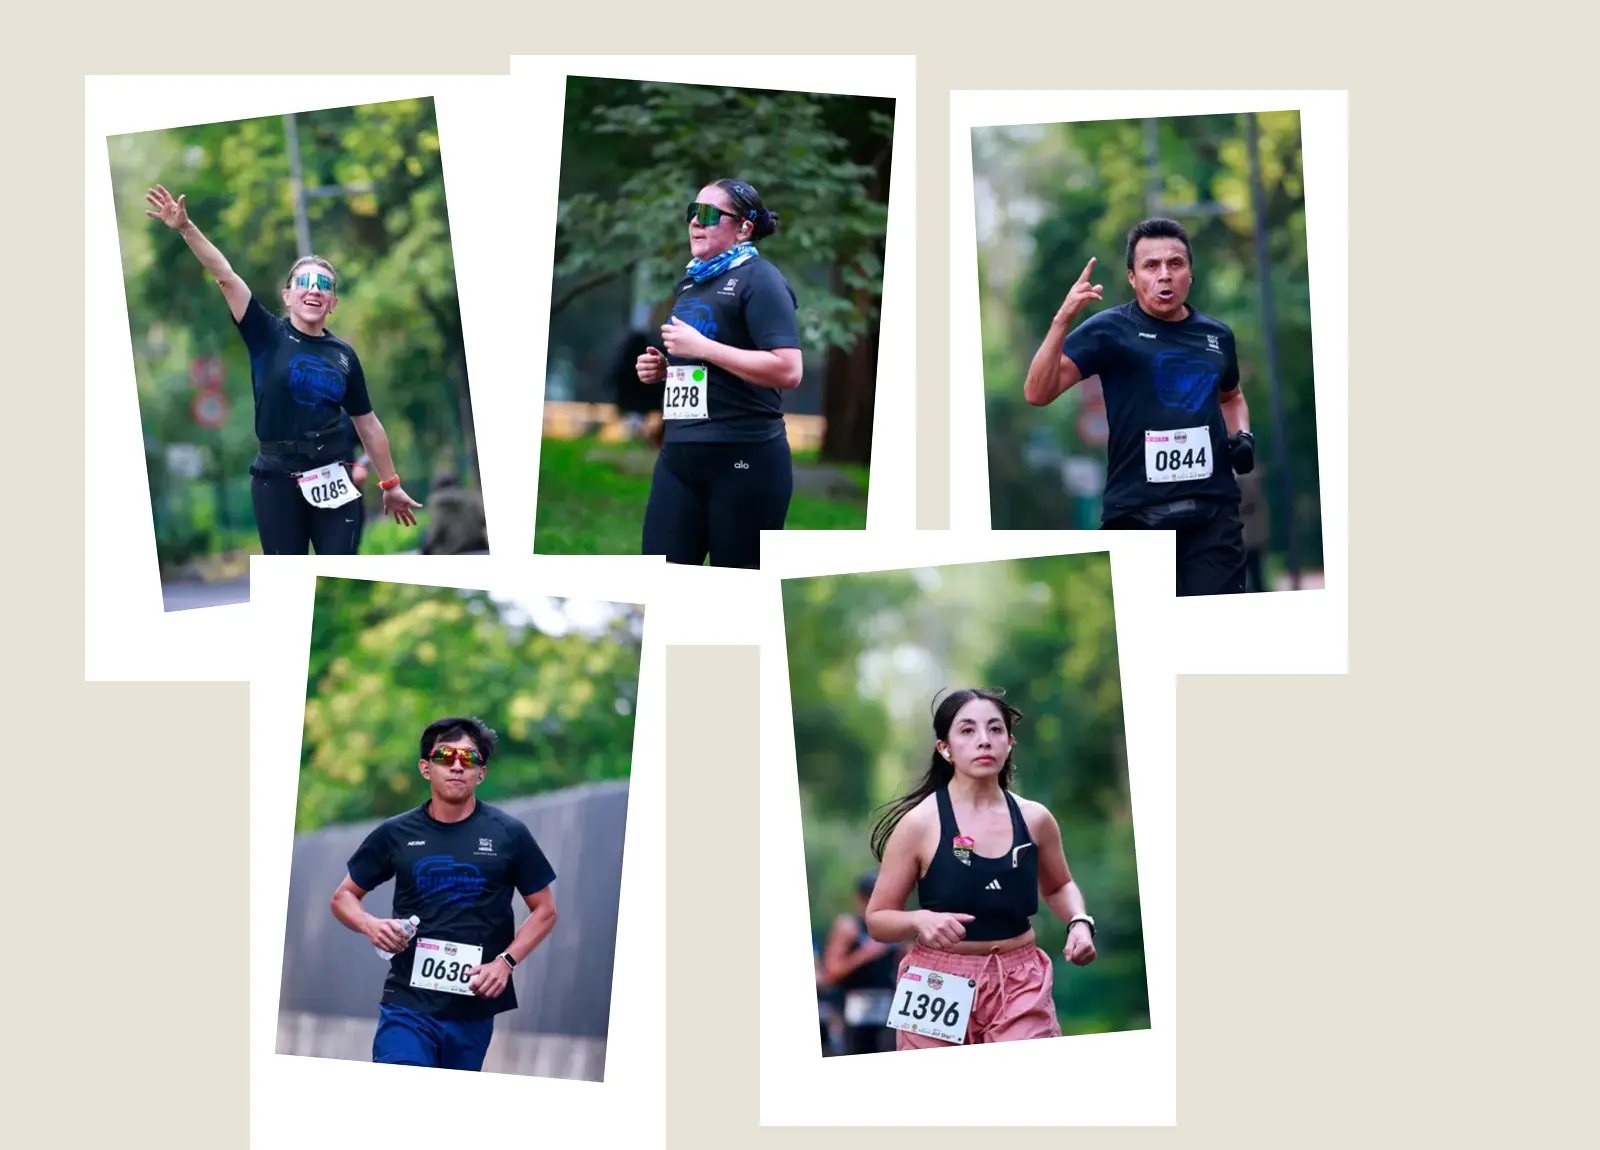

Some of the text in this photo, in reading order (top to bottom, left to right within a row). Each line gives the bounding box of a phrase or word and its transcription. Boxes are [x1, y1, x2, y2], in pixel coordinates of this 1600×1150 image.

[665, 385, 699, 408] 1278
[734, 459, 750, 470] alo
[1155, 446, 1207, 472] 0844
[311, 478, 348, 503] 0185
[898, 990, 960, 1027] 1396
